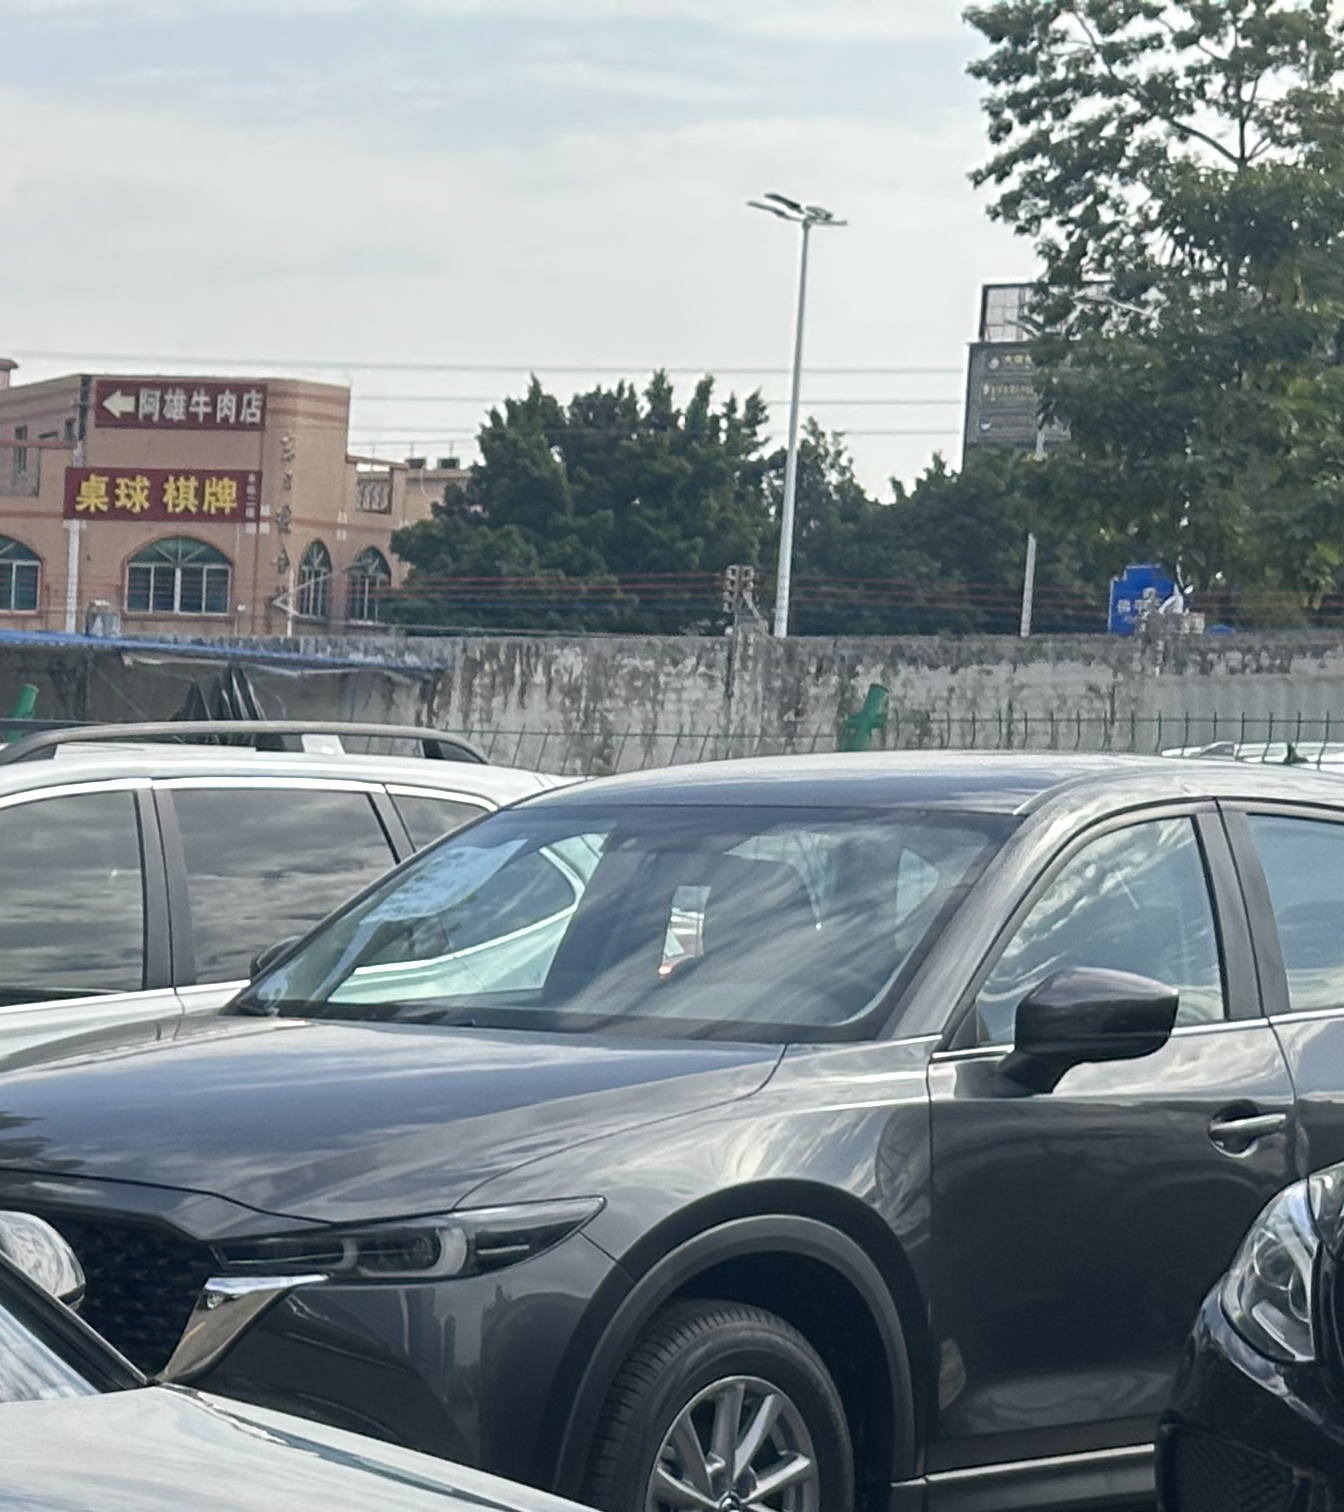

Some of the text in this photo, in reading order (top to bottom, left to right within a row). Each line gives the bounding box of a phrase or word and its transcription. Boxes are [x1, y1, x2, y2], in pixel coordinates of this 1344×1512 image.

[138, 387, 262, 424] 阿雄牛肉店
[75, 473, 238, 515] 桌球 棋牌
